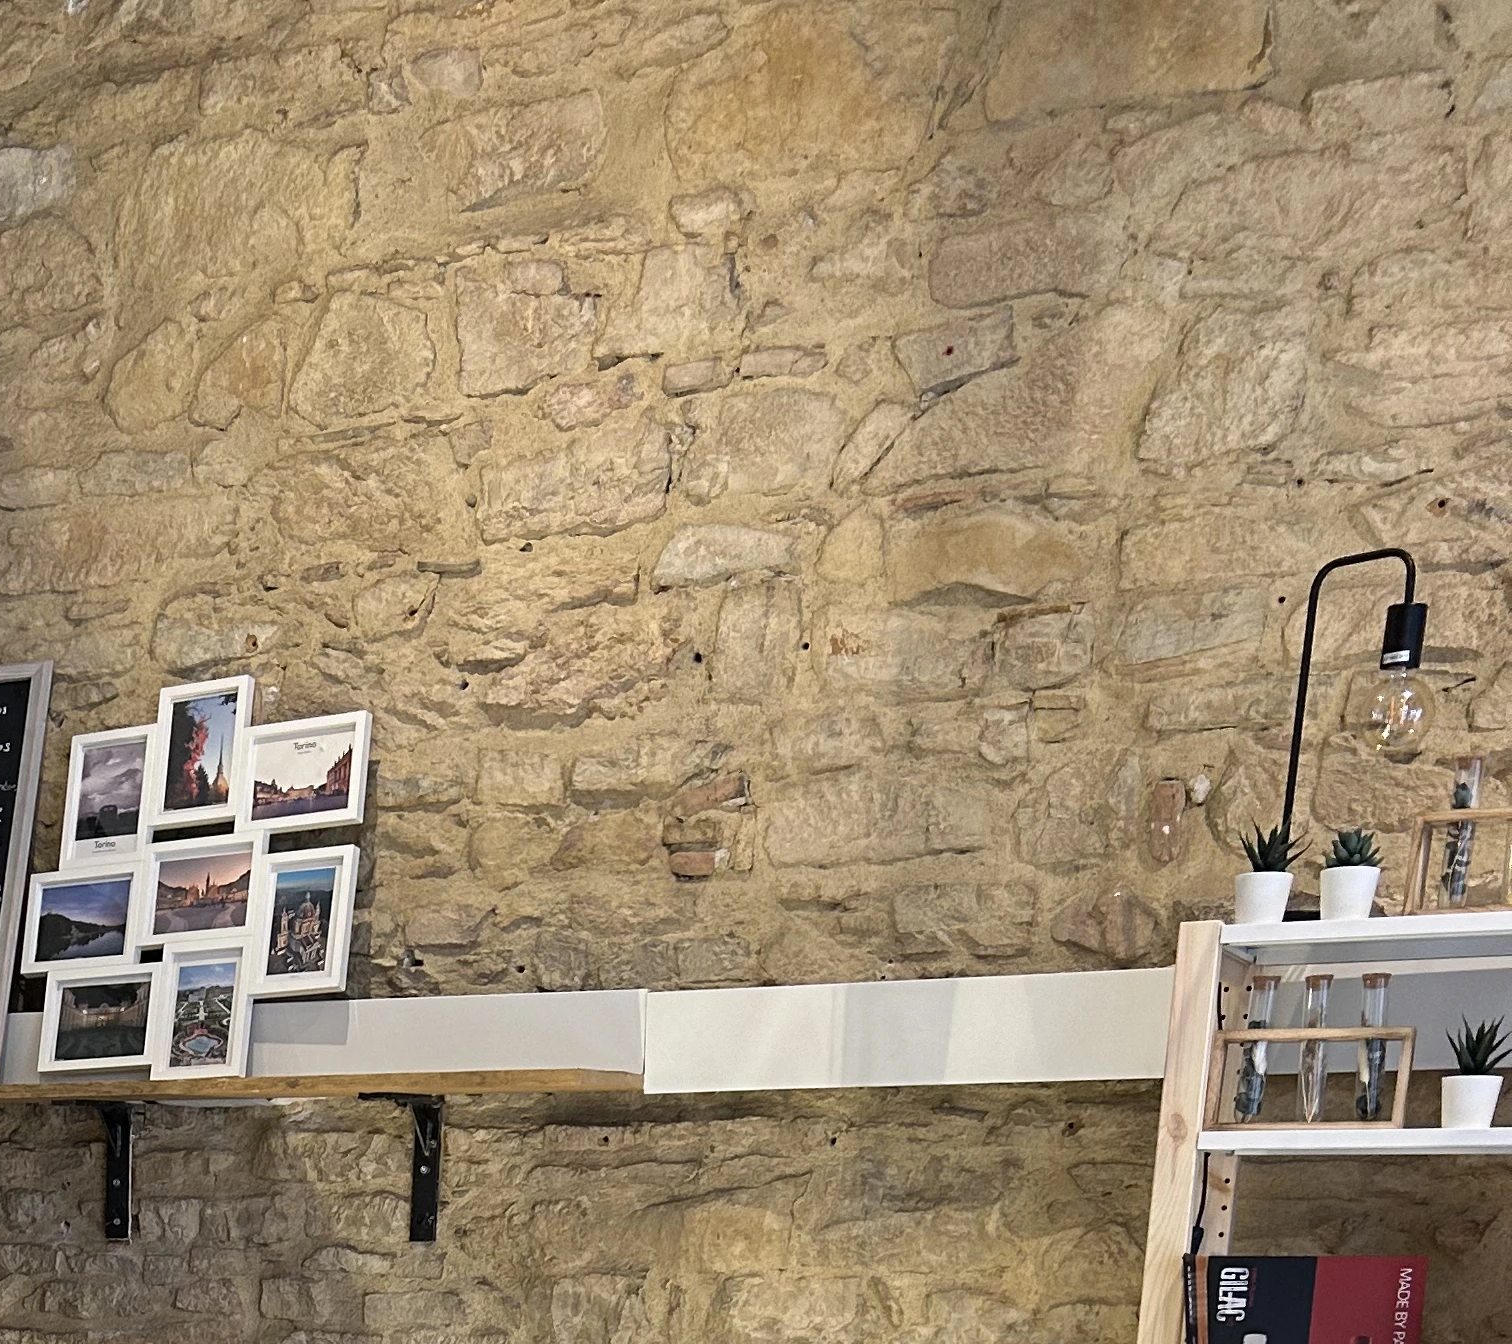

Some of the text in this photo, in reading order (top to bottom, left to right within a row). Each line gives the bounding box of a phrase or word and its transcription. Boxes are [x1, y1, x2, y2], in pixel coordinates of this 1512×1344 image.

[293, 741, 317, 751] Torino
[93, 840, 117, 849] Torino
[1216, 1267, 1250, 1322] GILAC
[1395, 1267, 1413, 1310] MADE
[1394, 1311, 1408, 1329] BY
